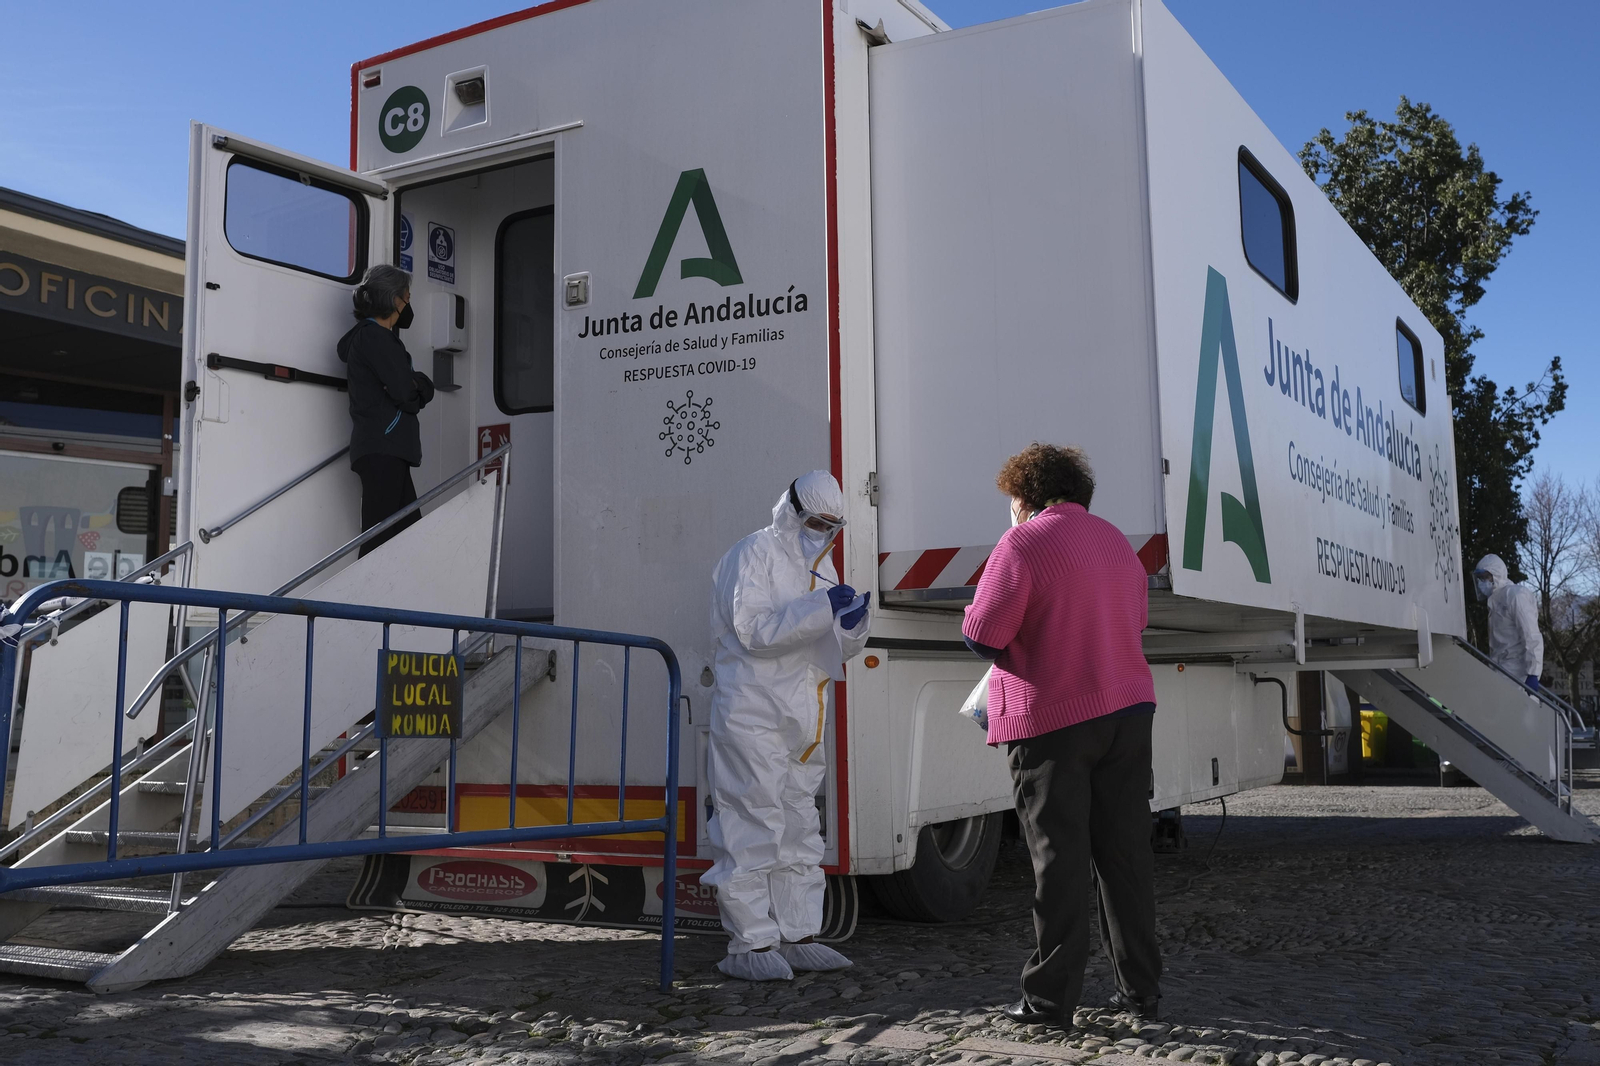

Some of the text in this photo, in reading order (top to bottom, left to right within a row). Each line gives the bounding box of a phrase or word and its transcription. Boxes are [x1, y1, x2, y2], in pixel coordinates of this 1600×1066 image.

[384, 102, 424, 137] C8
[0, 262, 184, 334] OFICIN
[578, 284, 808, 339] Junta de Andalucía
[600, 328, 785, 360] Consejería de Salud y Familias
[624, 357, 757, 383] RESPUESTA COVID-19
[1264, 317, 1422, 482] Junta de Andalucía
[1288, 441, 1415, 535] Consejería de Salud y Familias
[1316, 537, 1406, 595] RESPUESTA COVID-19
[388, 653, 458, 677] POLICIA
[392, 683, 451, 706] LOCAL
[391, 713, 451, 735] RONDA
[395, 900, 434, 909] CAMUÑAS
[428, 885, 523, 896] CARROCEROS
[637, 915, 680, 925] CAMUS
